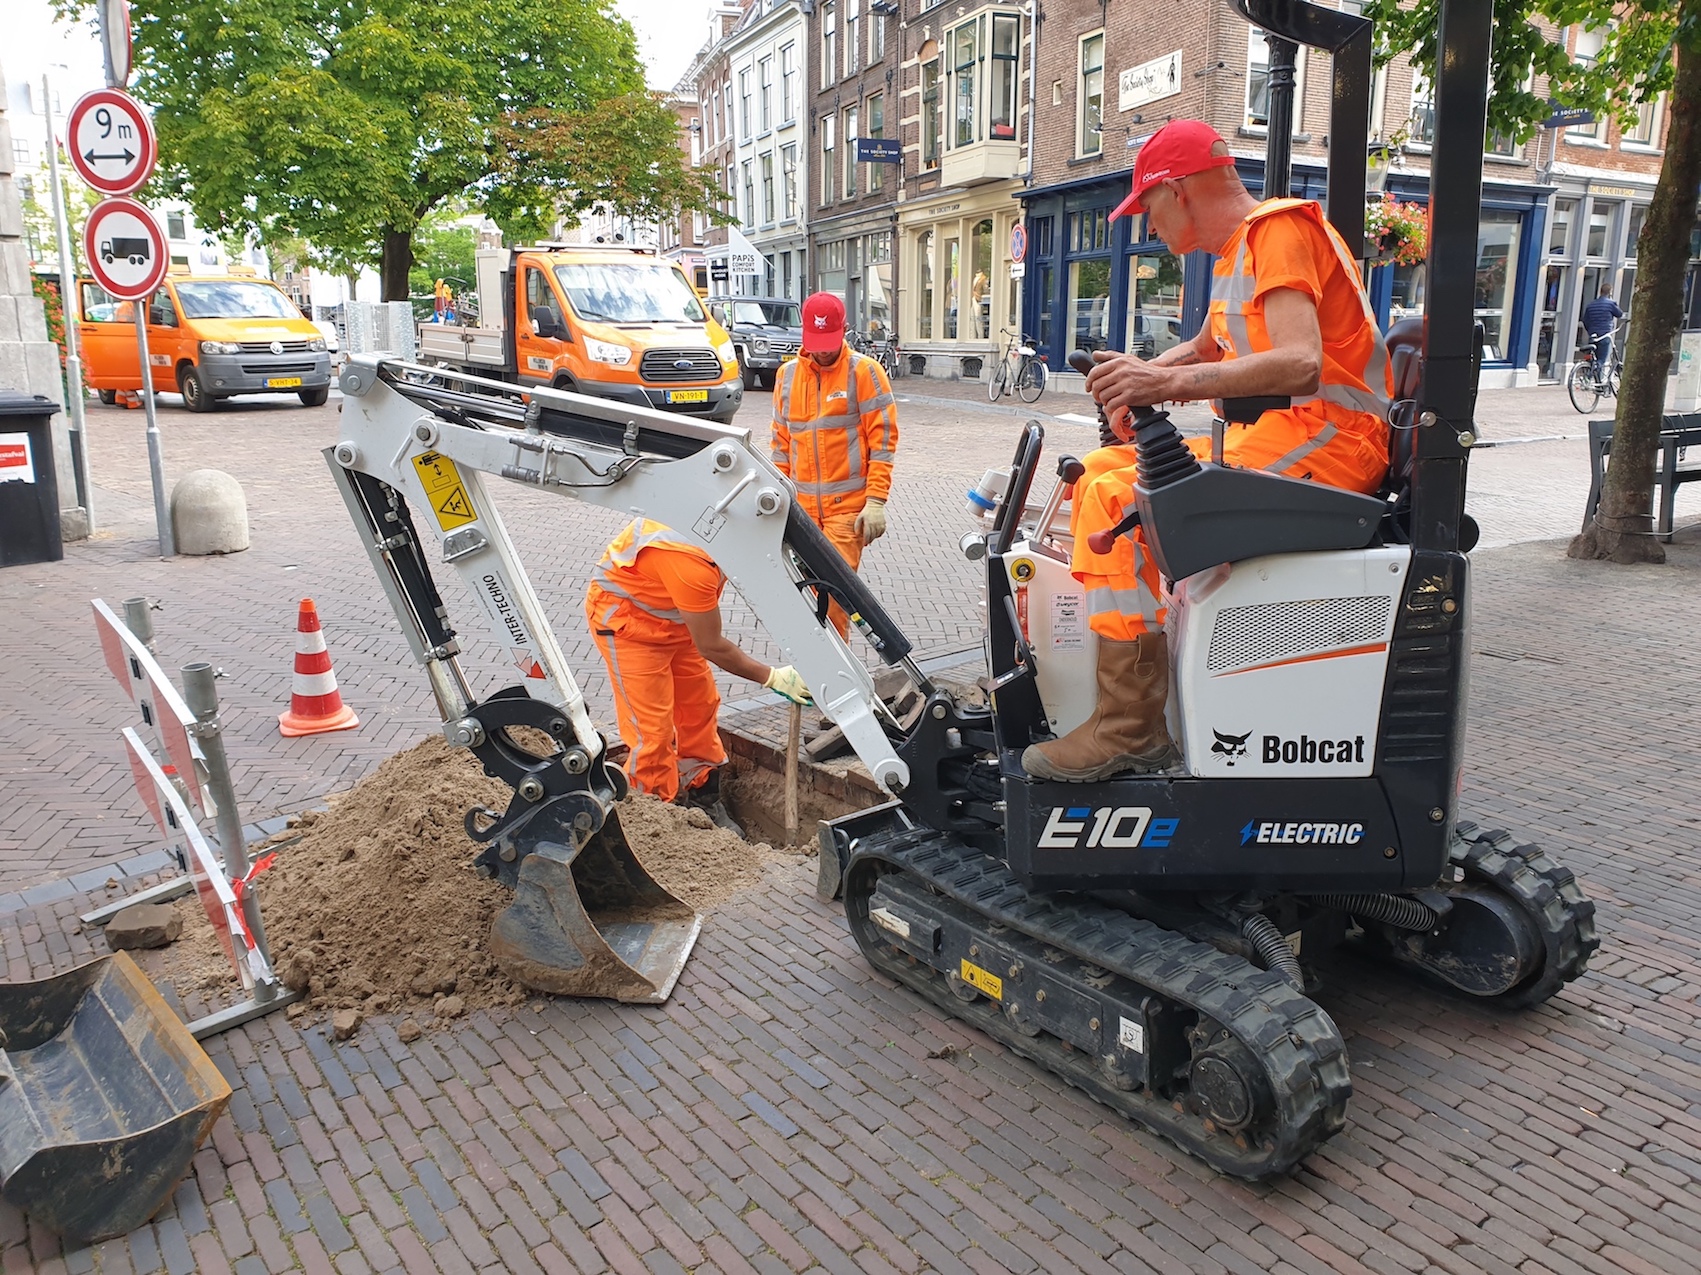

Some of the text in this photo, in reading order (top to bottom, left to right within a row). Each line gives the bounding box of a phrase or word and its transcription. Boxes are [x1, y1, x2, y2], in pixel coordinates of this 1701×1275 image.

[674, 391, 705, 400] VN-191-T
[482, 574, 528, 645] INTER-TECHNO
[1261, 734, 1365, 764] Bobcat
[1255, 822, 1364, 845] ELECTRIC
